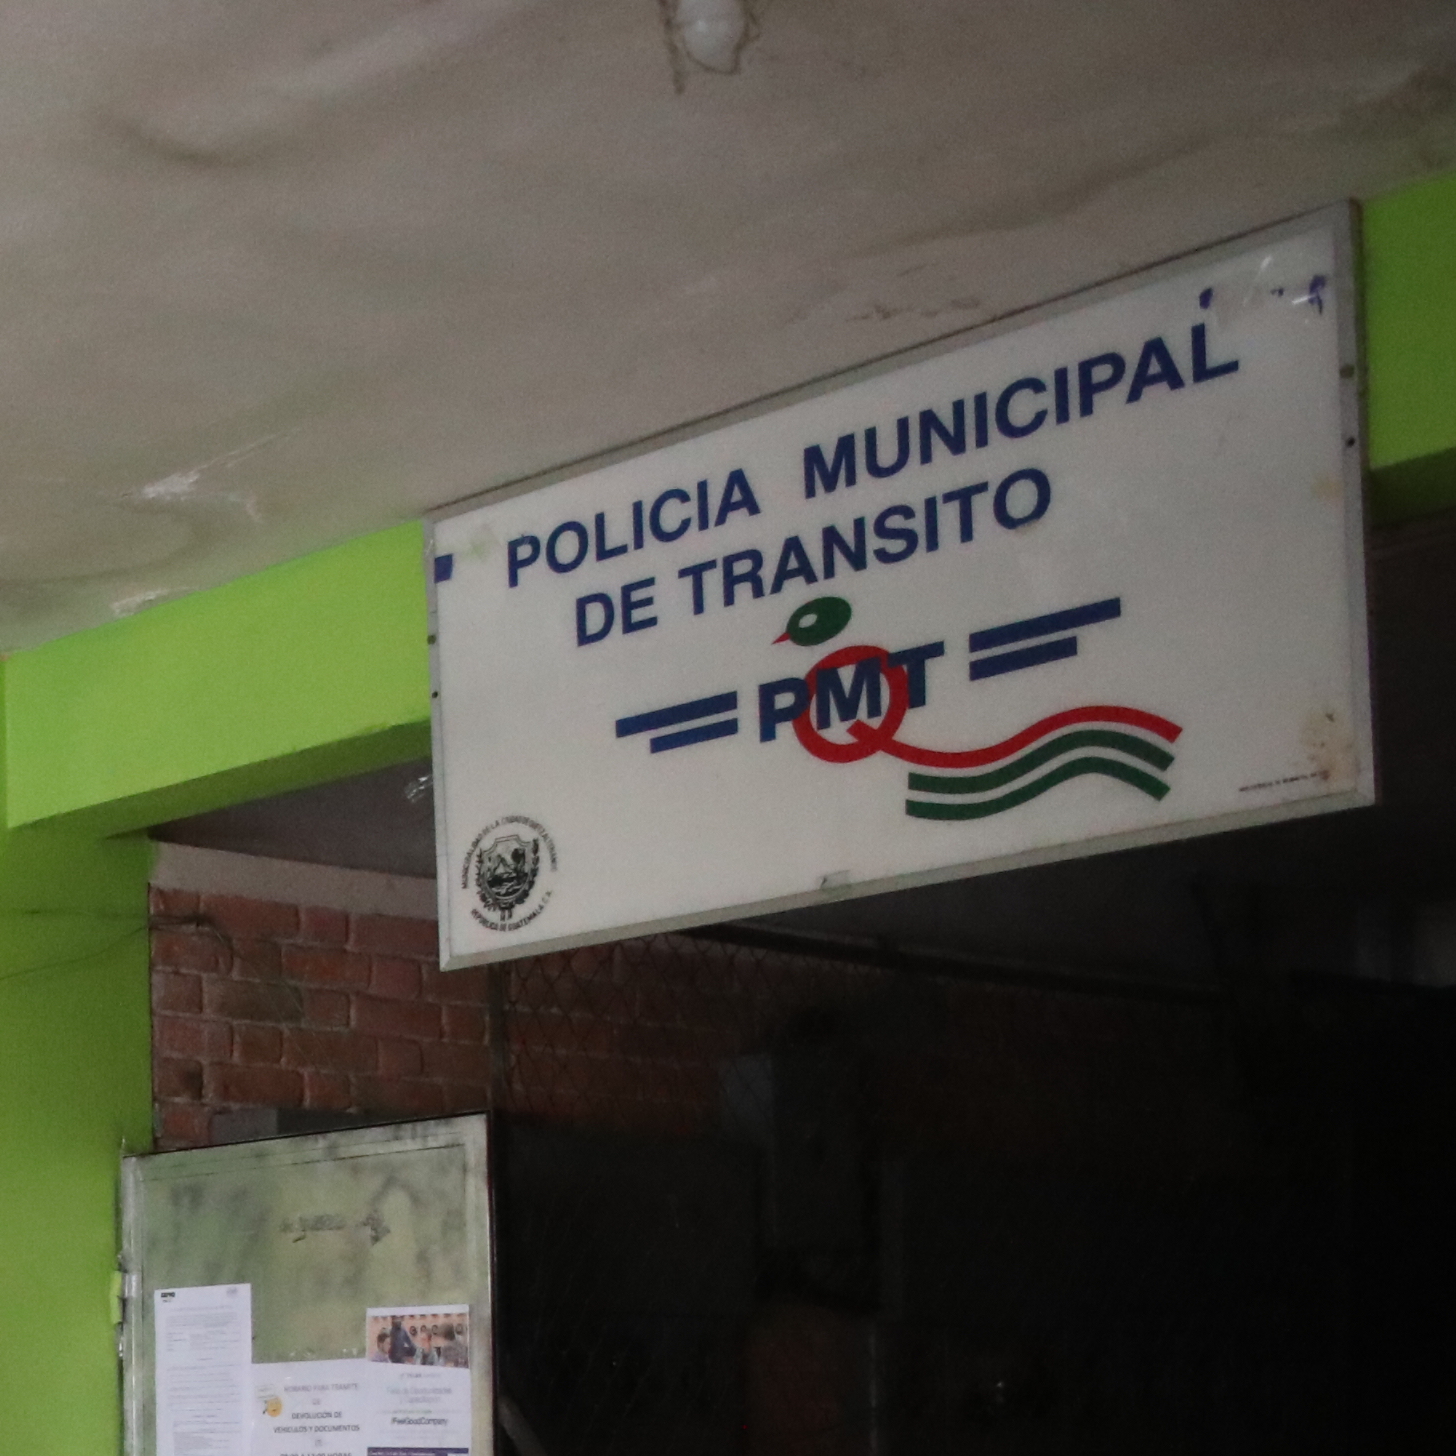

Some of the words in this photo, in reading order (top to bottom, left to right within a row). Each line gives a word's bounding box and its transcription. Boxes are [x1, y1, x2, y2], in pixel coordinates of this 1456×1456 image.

[506, 467, 762, 589] POLICIA
[802, 322, 1240, 499] MUNICIPAL
[574, 576, 659, 648] DE
[677, 467, 1053, 616] TRANSITO
